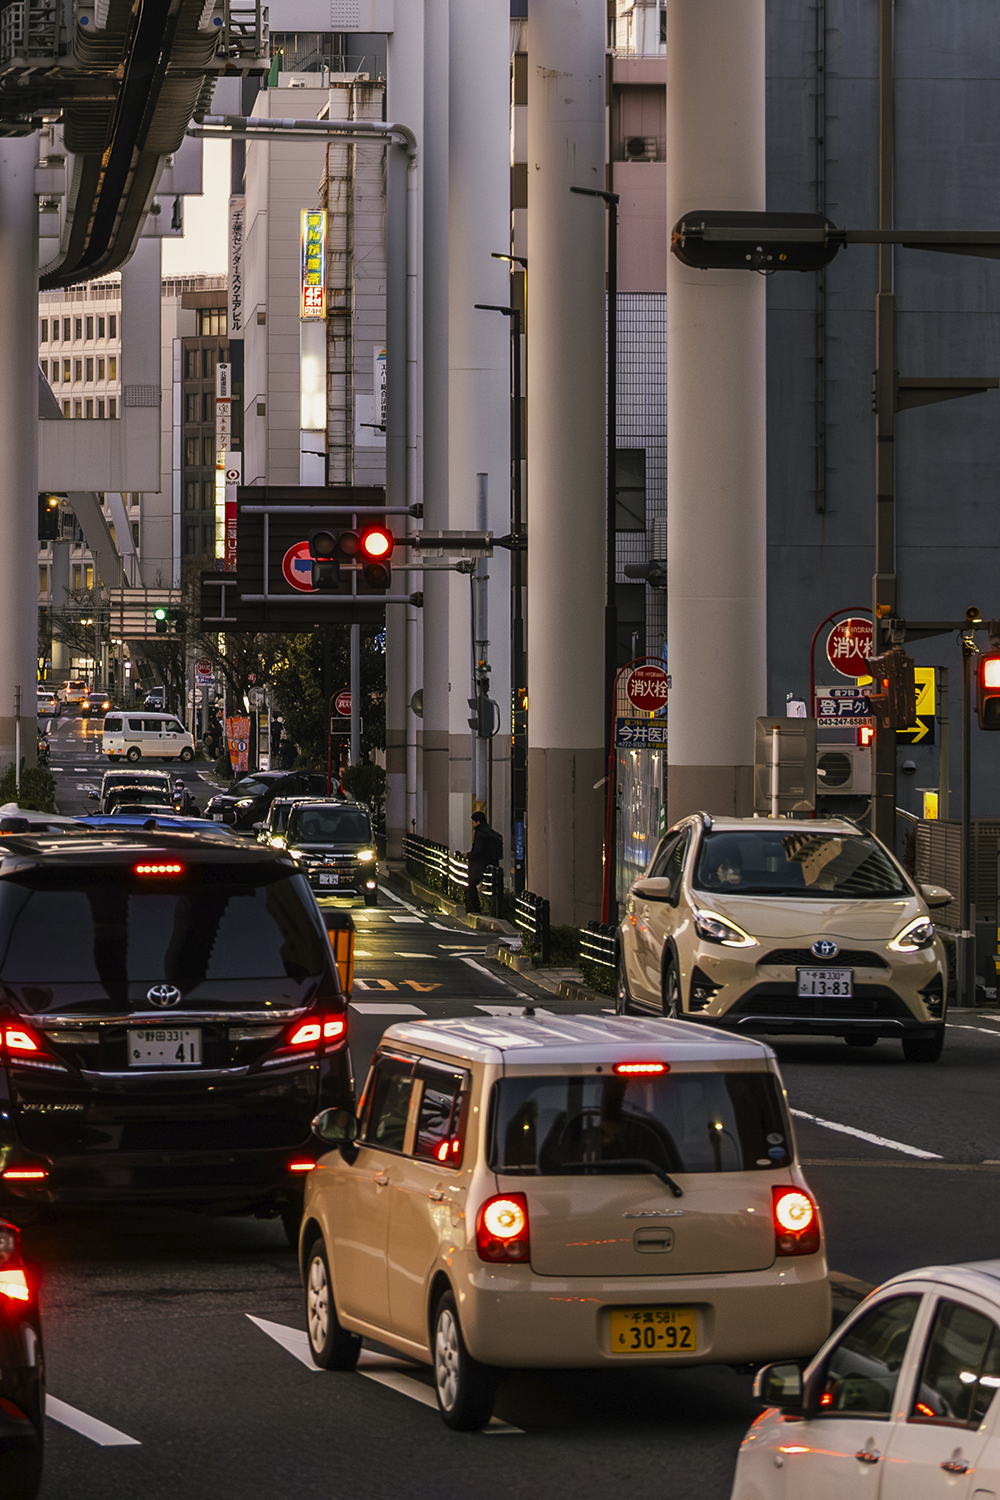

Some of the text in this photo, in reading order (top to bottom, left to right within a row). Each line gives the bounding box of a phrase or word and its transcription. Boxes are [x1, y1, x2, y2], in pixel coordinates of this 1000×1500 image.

[630, 679, 668, 698] 消火栓
[812, 981, 850, 995] 13-83
[145, 1031, 184, 1042] 野田 331
[631, 1312, 676, 1324] 千葉 581
[629, 1325, 693, 1349] 30-92
